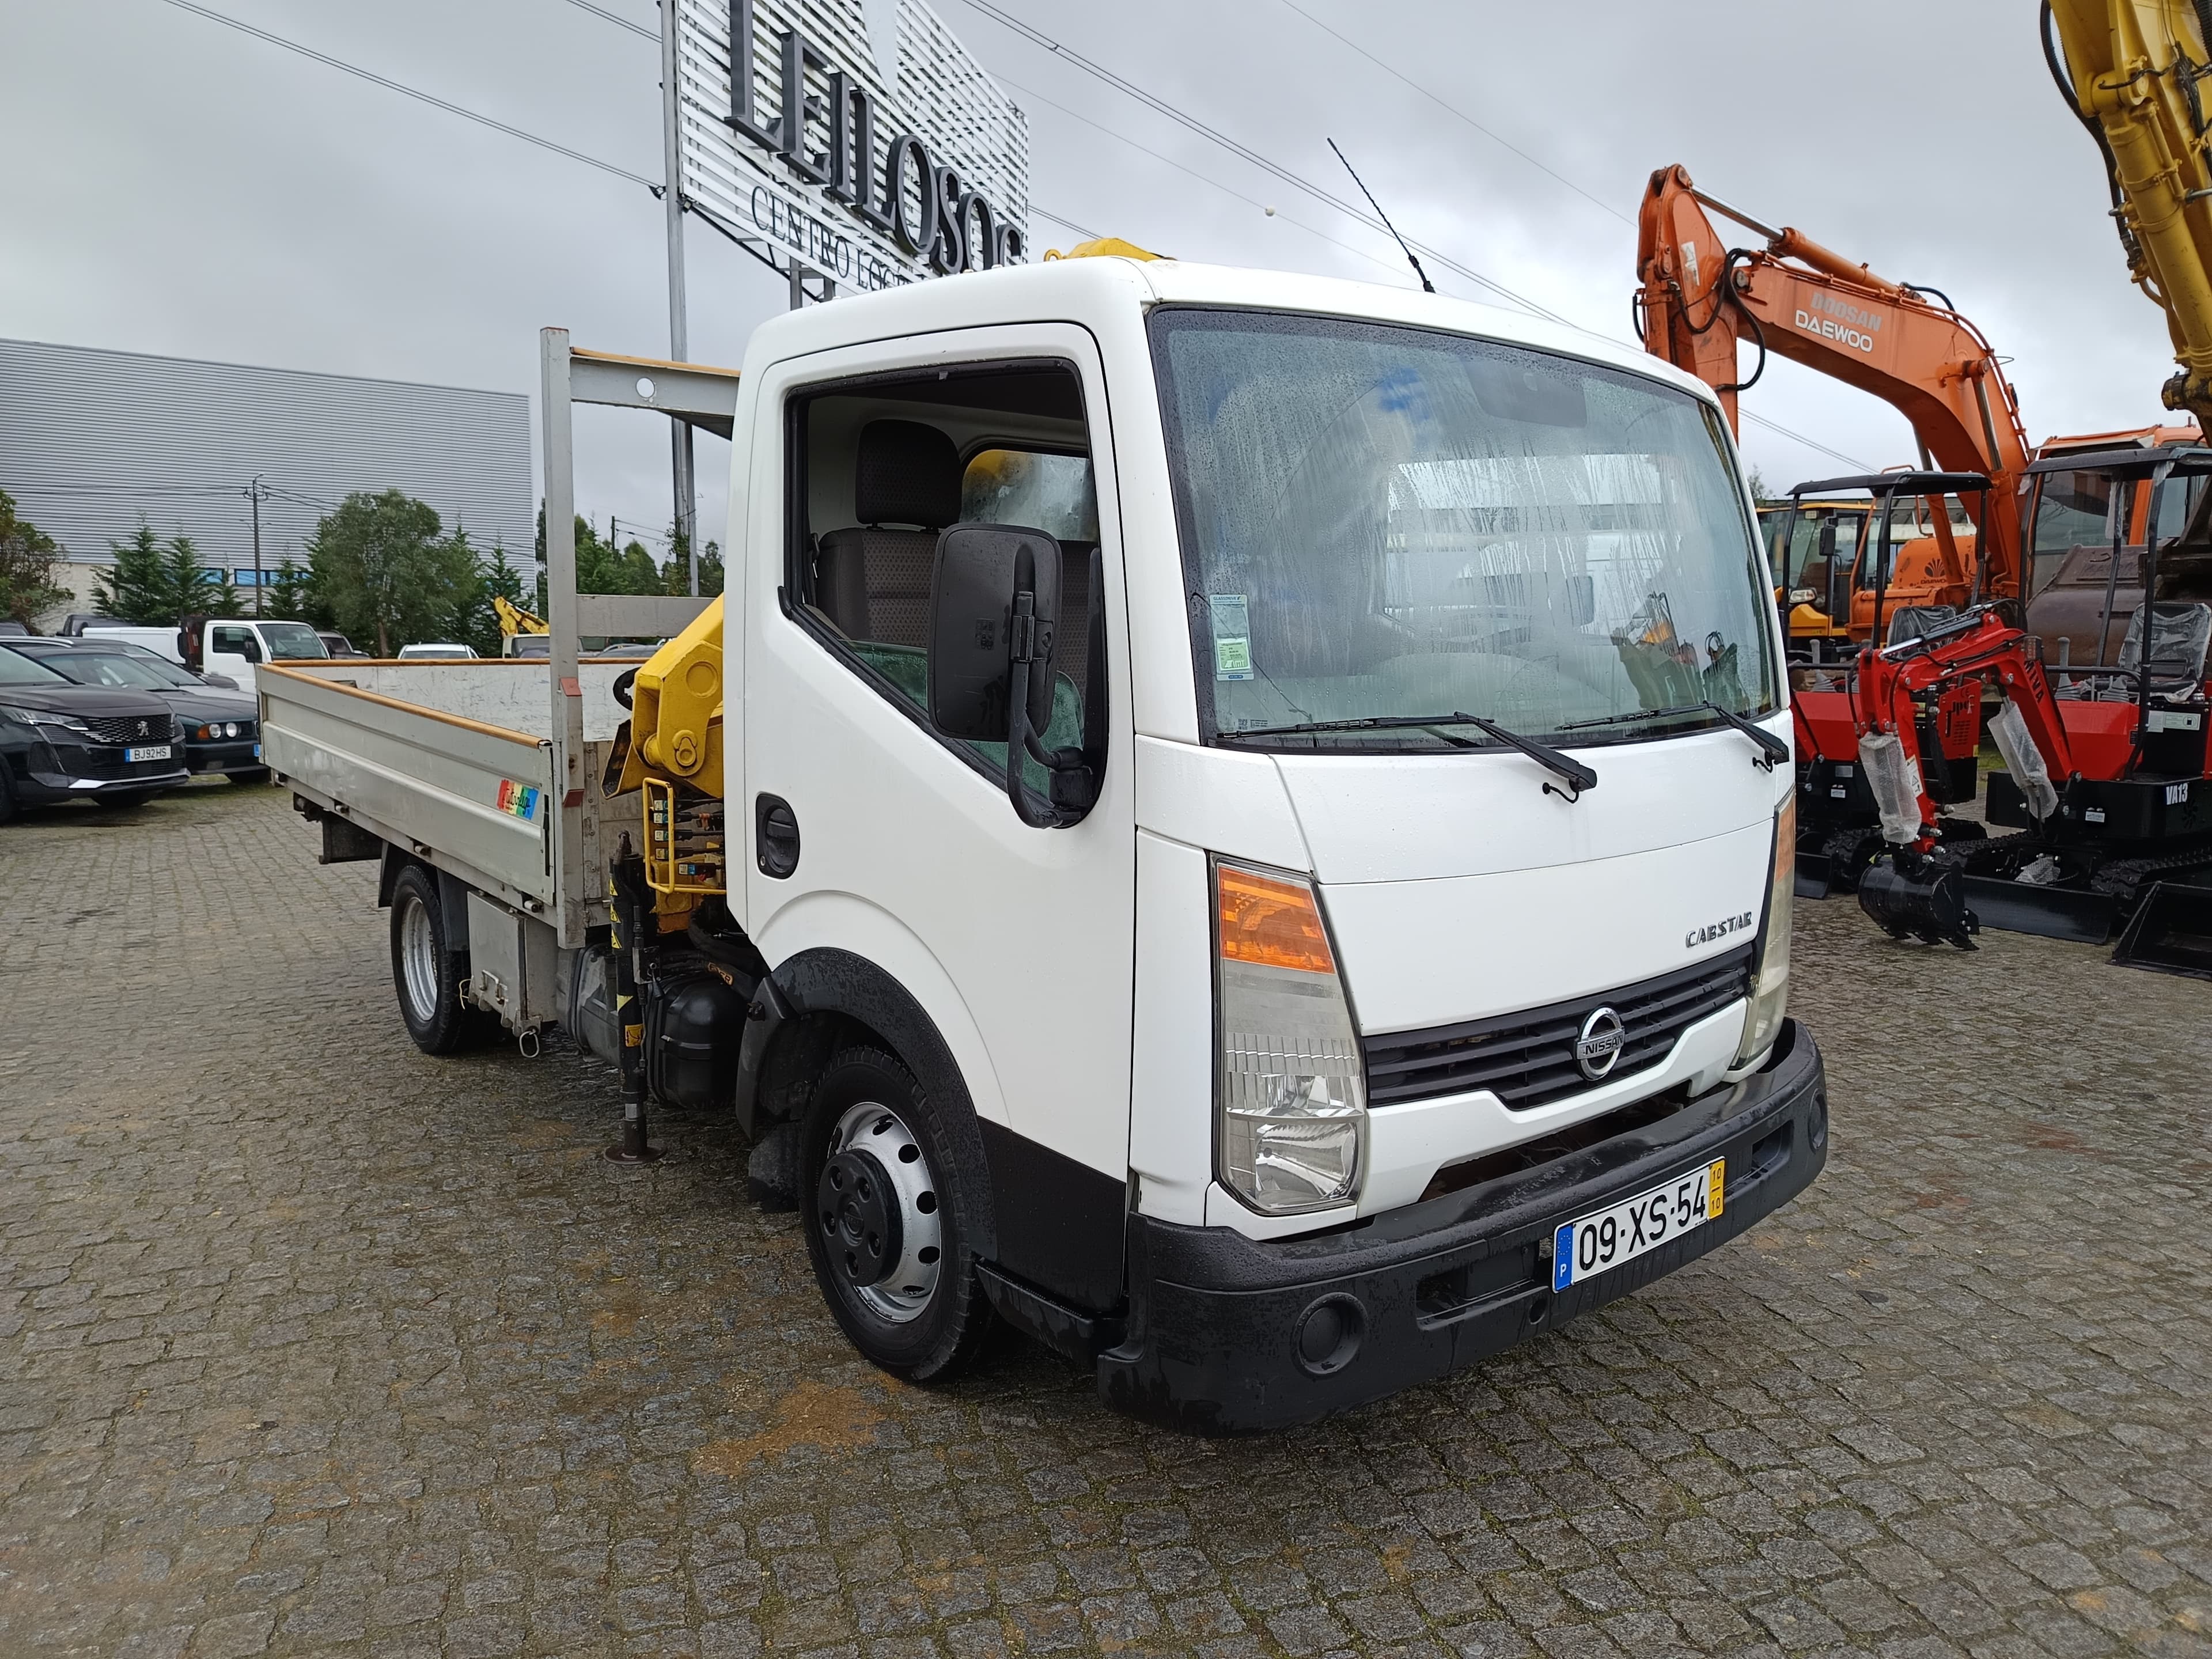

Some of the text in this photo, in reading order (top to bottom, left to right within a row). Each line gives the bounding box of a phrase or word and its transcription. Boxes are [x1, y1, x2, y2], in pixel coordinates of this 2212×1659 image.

[752, 185, 850, 278] CENTRO
[1811, 293, 1882, 332] DOOSAN
[1795, 309, 1873, 353] DAEWOO
[134, 748, 166, 760] BJ92HS
[2166, 783, 2188, 805] VA13
[1685, 911, 1752, 948] CABSTAR
[1585, 1035, 1623, 1055] NISSAN
[1712, 1167, 1722, 1181] 10
[1711, 1196, 1721, 1211] 10
[1560, 1263, 1567, 1277] P
